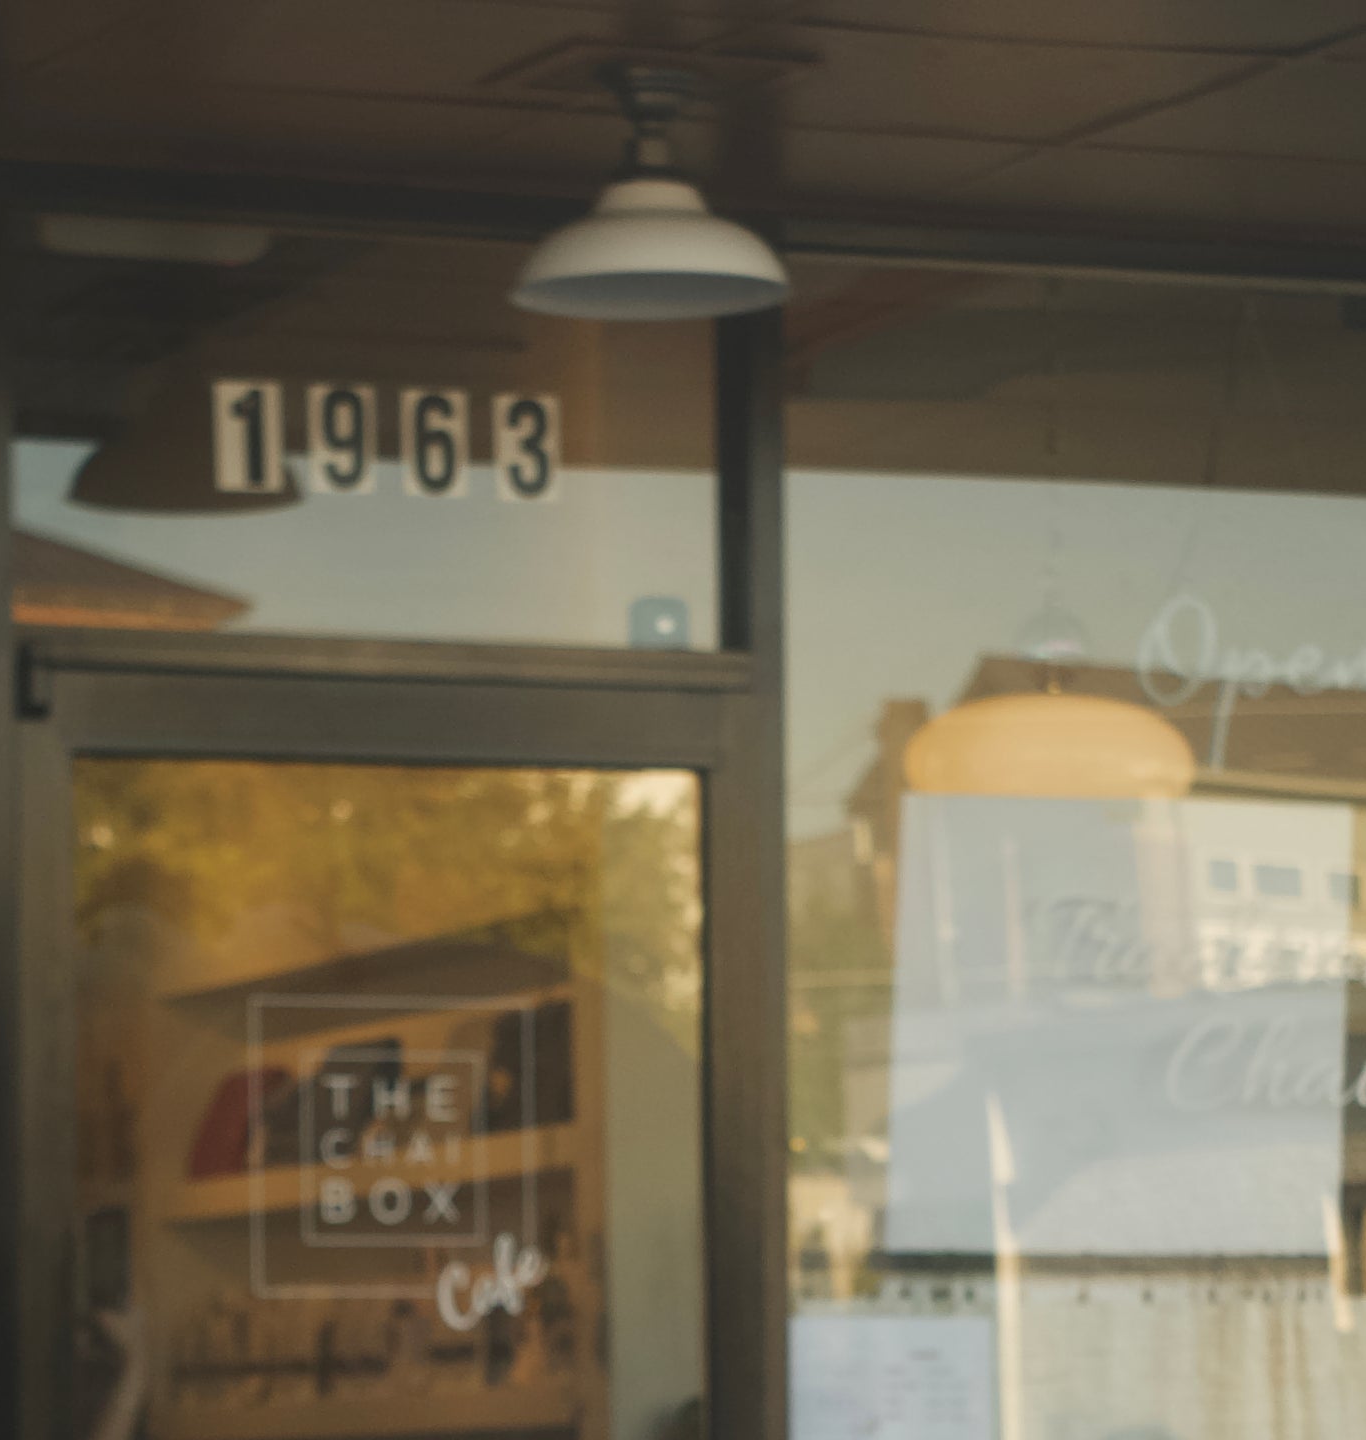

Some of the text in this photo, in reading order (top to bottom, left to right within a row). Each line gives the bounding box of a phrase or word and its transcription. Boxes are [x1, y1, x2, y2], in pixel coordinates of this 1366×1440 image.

[231, 388, 551, 499] 1963
[320, 1072, 460, 1122] THE
[319, 1126, 462, 1170] CHAI
[319, 1175, 461, 1226] BOX
